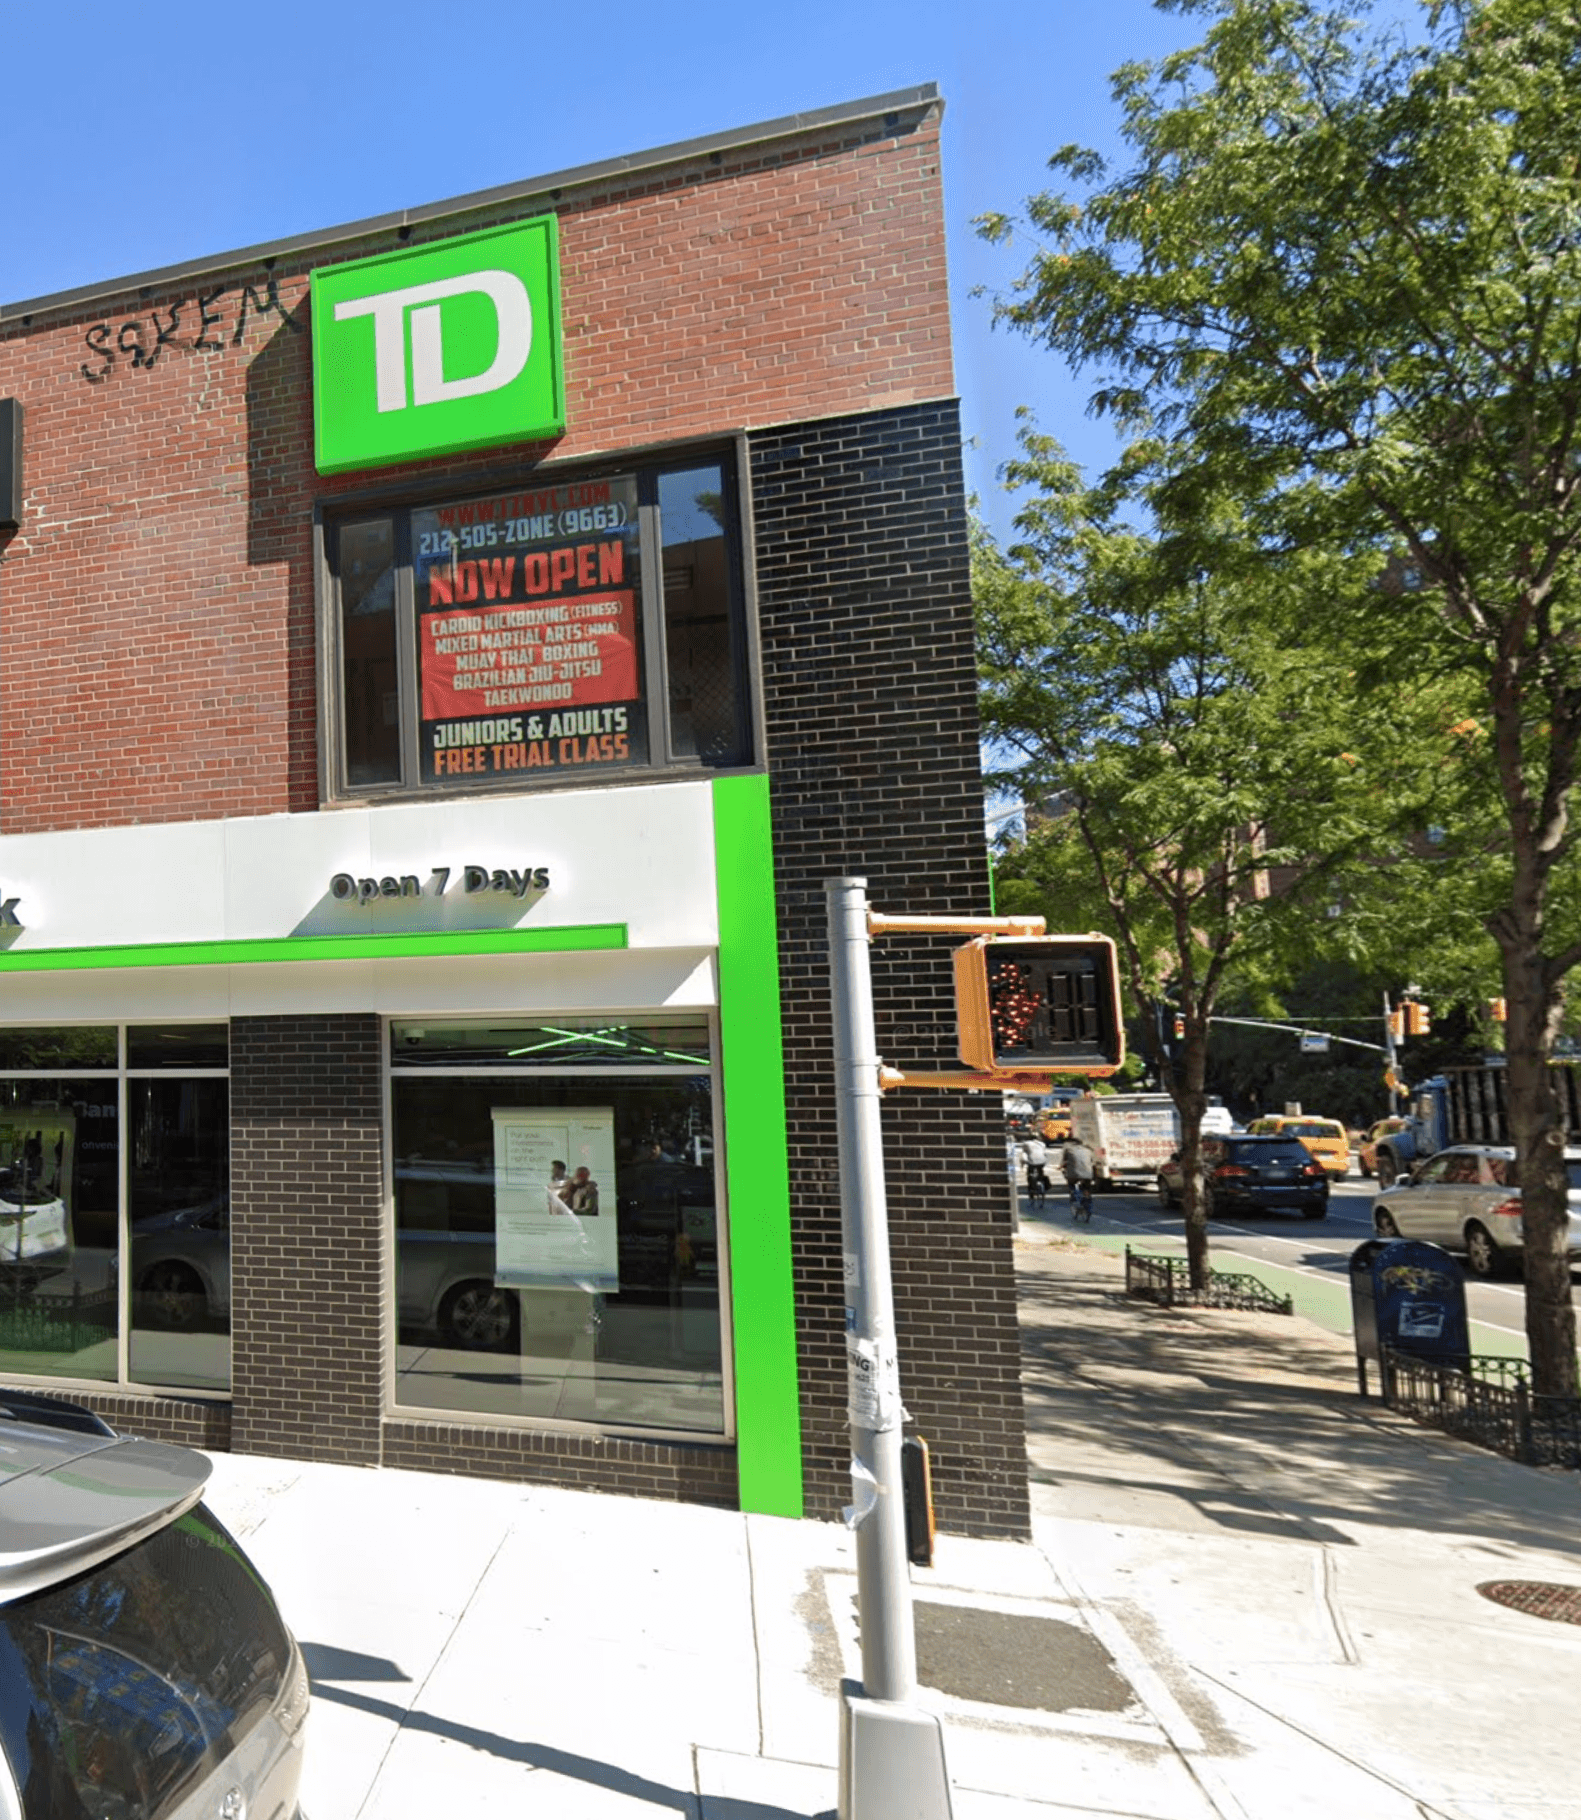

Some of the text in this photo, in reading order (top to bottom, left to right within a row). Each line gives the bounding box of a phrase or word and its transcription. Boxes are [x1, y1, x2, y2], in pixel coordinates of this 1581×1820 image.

[334, 269, 533, 413] TD
[420, 501, 627, 555] 212-505-ZONE (9663)
[430, 541, 624, 606] NOW OPEN
[430, 600, 623, 636] CARDIO KICKBOXING (FITNESS)
[435, 621, 619, 655] MIXED MARTIAL ARTS (MMA)
[453, 659, 603, 691] BRAZILIAN JIU-JITSU
[456, 640, 599, 671] MUAY THAI BOXING
[484, 682, 573, 707] TAEKWONDO
[433, 707, 628, 748] JUNIORS & ADULTS
[434, 733, 629, 775] FREE TRIAL CLASS
[330, 865, 551, 907] Open 7 Days
